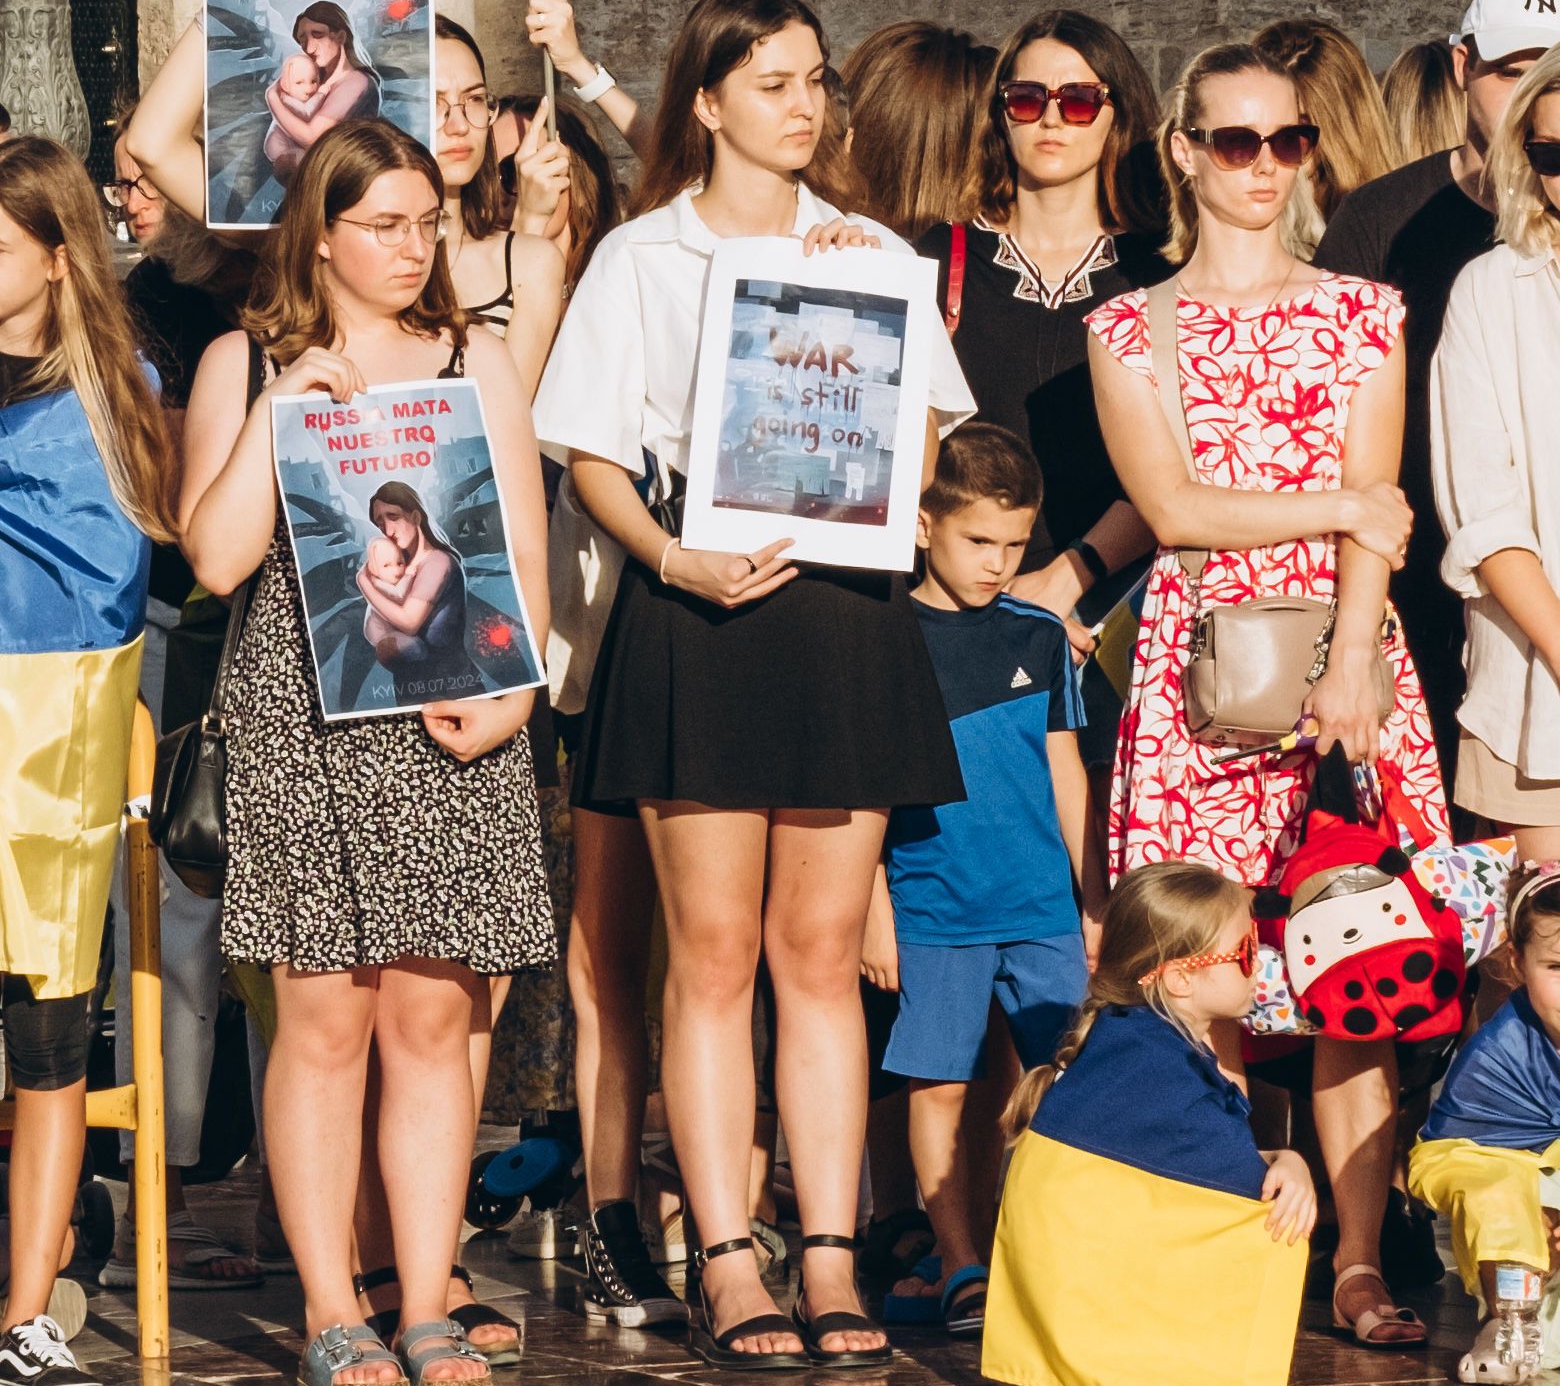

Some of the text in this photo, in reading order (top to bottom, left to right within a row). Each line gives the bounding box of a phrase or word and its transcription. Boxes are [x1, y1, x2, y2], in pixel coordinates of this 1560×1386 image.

[769, 326, 861, 377] WAR
[392, 398, 453, 419] MATA
[767, 380, 863, 413] is still
[327, 425, 436, 452] NUESTRO
[753, 415, 864, 453] going on
[339, 451, 432, 476] FUTURO
